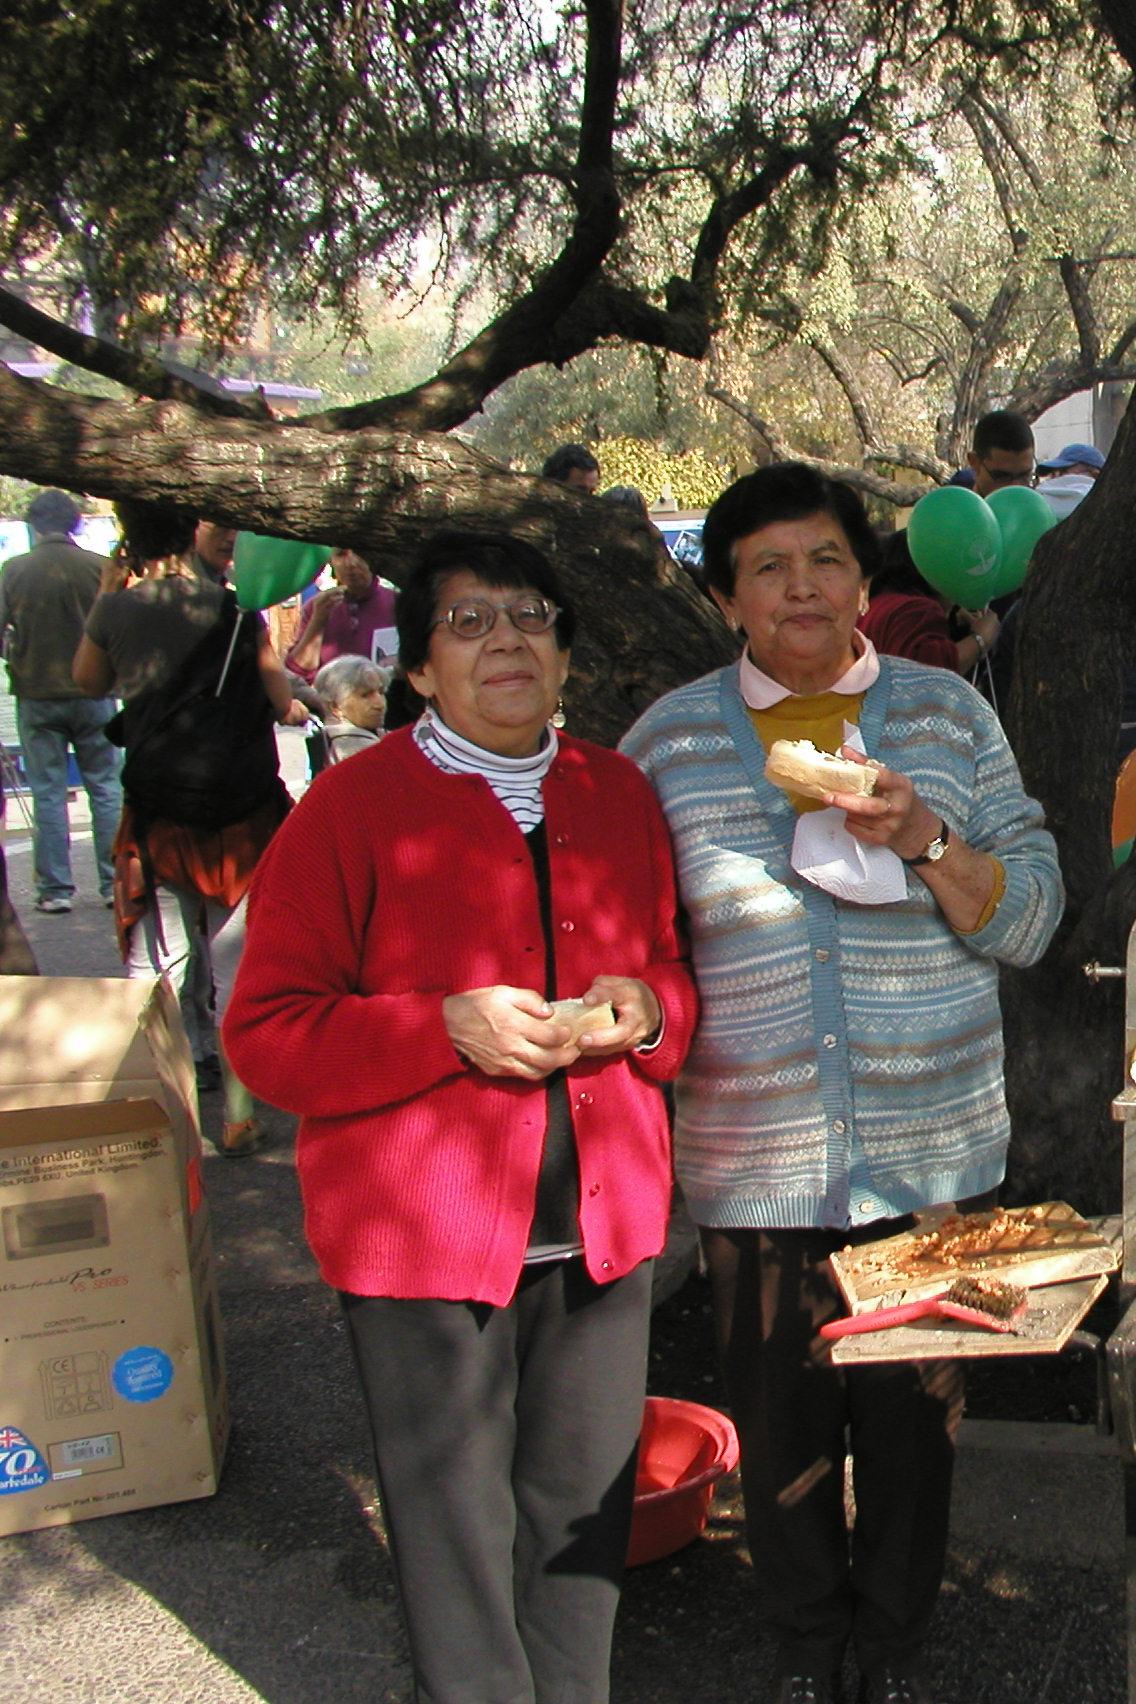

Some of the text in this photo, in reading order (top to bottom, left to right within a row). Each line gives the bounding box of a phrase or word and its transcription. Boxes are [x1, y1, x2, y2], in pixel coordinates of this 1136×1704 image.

[13, 1145, 102, 1167] International
[33, 1161, 79, 1174] Business
[69, 1267, 113, 1285] Pro
[93, 1274, 129, 1290] SERIES
